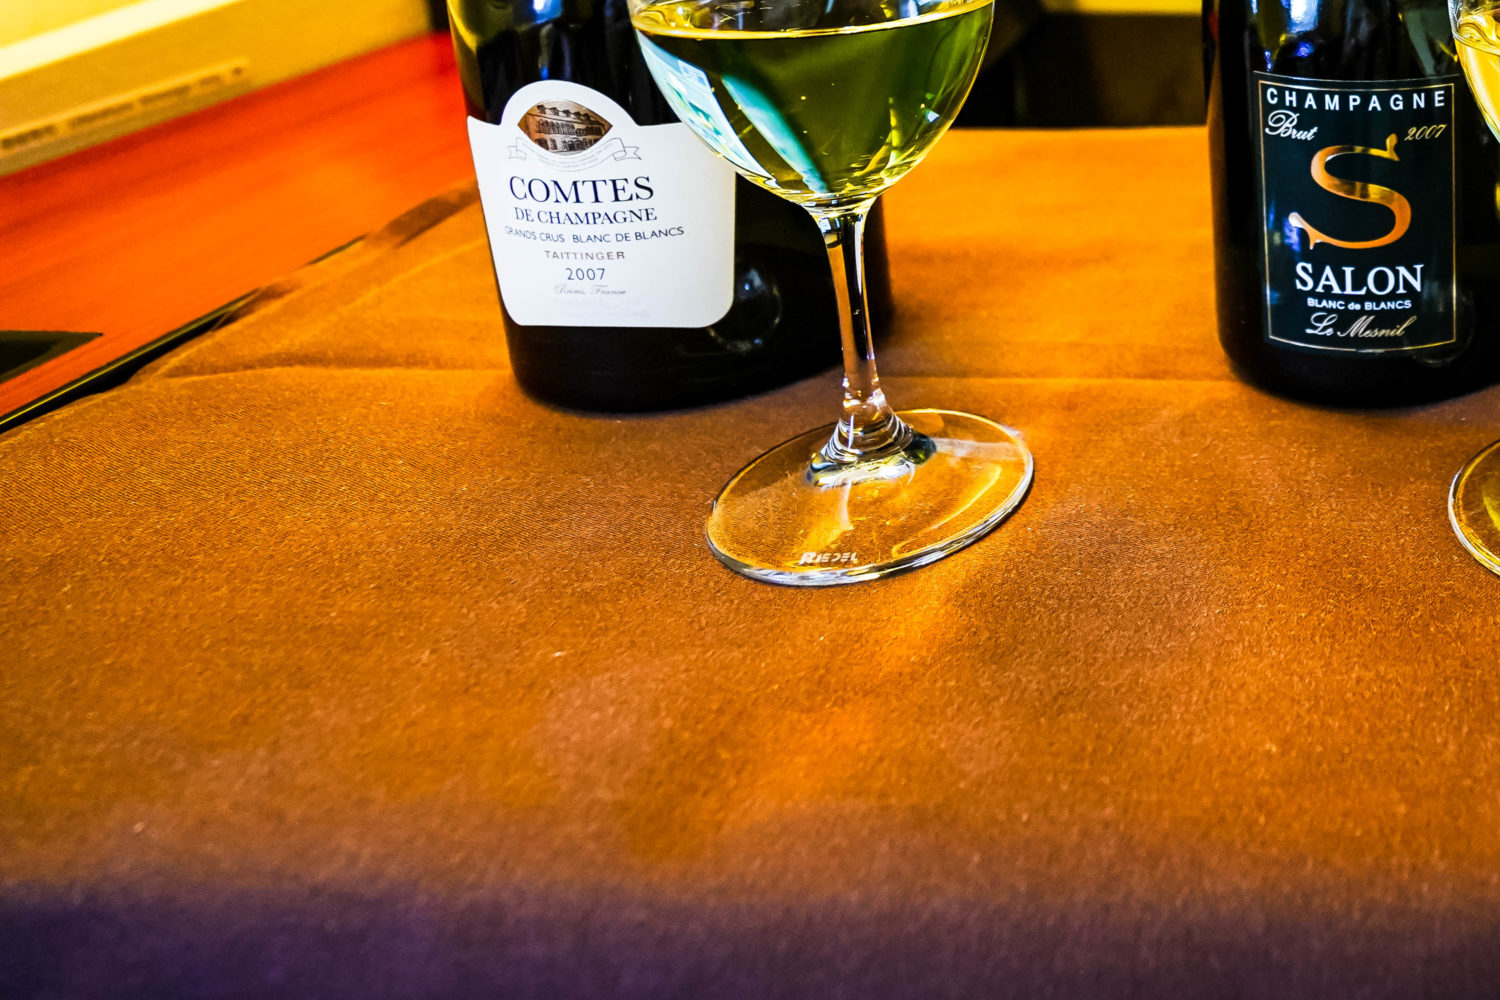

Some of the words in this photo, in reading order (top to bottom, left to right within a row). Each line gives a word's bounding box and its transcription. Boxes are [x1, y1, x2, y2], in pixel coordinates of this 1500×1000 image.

[1266, 87, 1446, 112] CHAMPAGNE
[1264, 109, 1319, 141] Brut
[1404, 123, 1448, 141] 2007
[509, 176, 654, 204] COMTES
[1288, 133, 1412, 250] S
[514, 206, 534, 223] DE
[537, 207, 658, 225] CHAMPAGNE
[539, 231, 566, 243] CRUS
[572, 232, 612, 244] BLANC
[615, 232, 632, 243] DE
[635, 226, 685, 242] BLANCS
[544, 250, 625, 261] TAITTINGER
[565, 267, 607, 281] 2007
[1295, 262, 1425, 296] SALON
[1307, 297, 1346, 310] BLANC
[1347, 302, 1361, 311] de
[1364, 300, 1412, 311] BLANCS
[1305, 312, 1338, 336] Le
[1336, 315, 1417, 338] Mesnil
